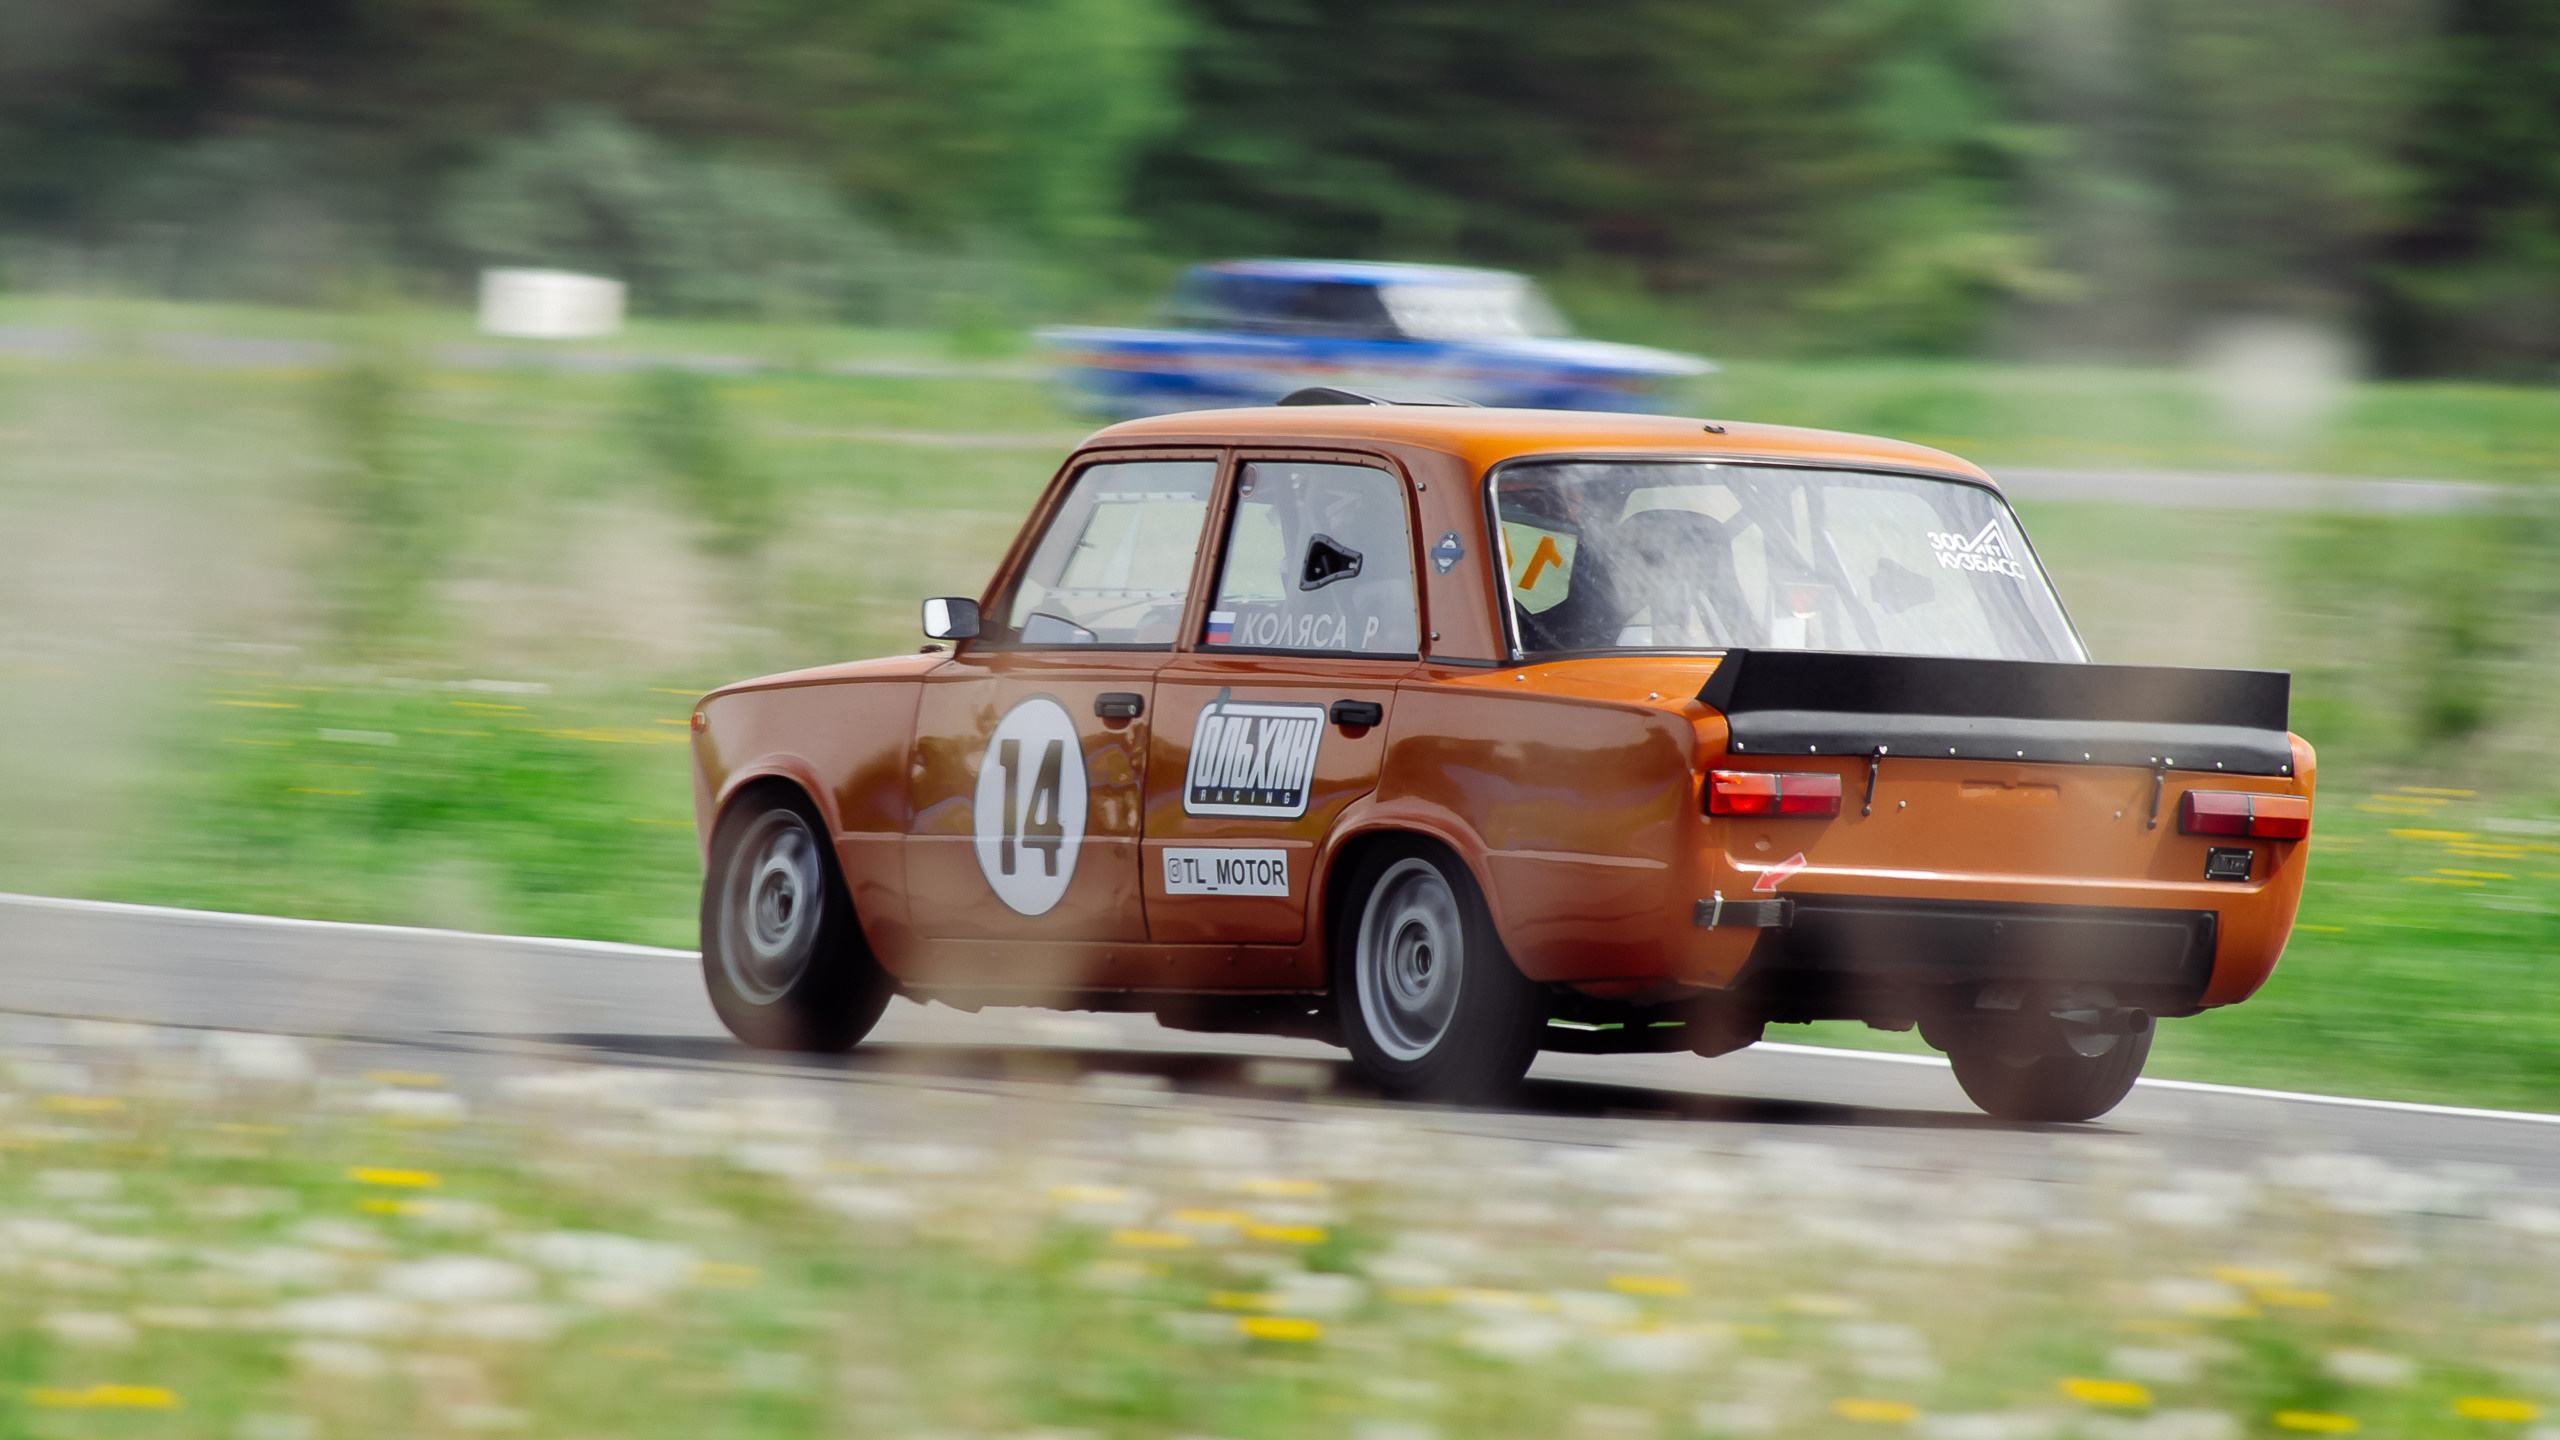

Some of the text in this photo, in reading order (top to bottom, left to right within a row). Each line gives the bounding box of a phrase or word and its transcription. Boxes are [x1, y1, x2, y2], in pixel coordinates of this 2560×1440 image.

[1926, 532, 1969, 552] 300
[1935, 551, 2026, 580] КУЗБАСС
[1240, 612, 1347, 649] КОЛЯСА
[1195, 716, 1314, 790] ОЛЬХИН
[999, 738, 1065, 878] 14
[1200, 788, 1293, 805] RACING
